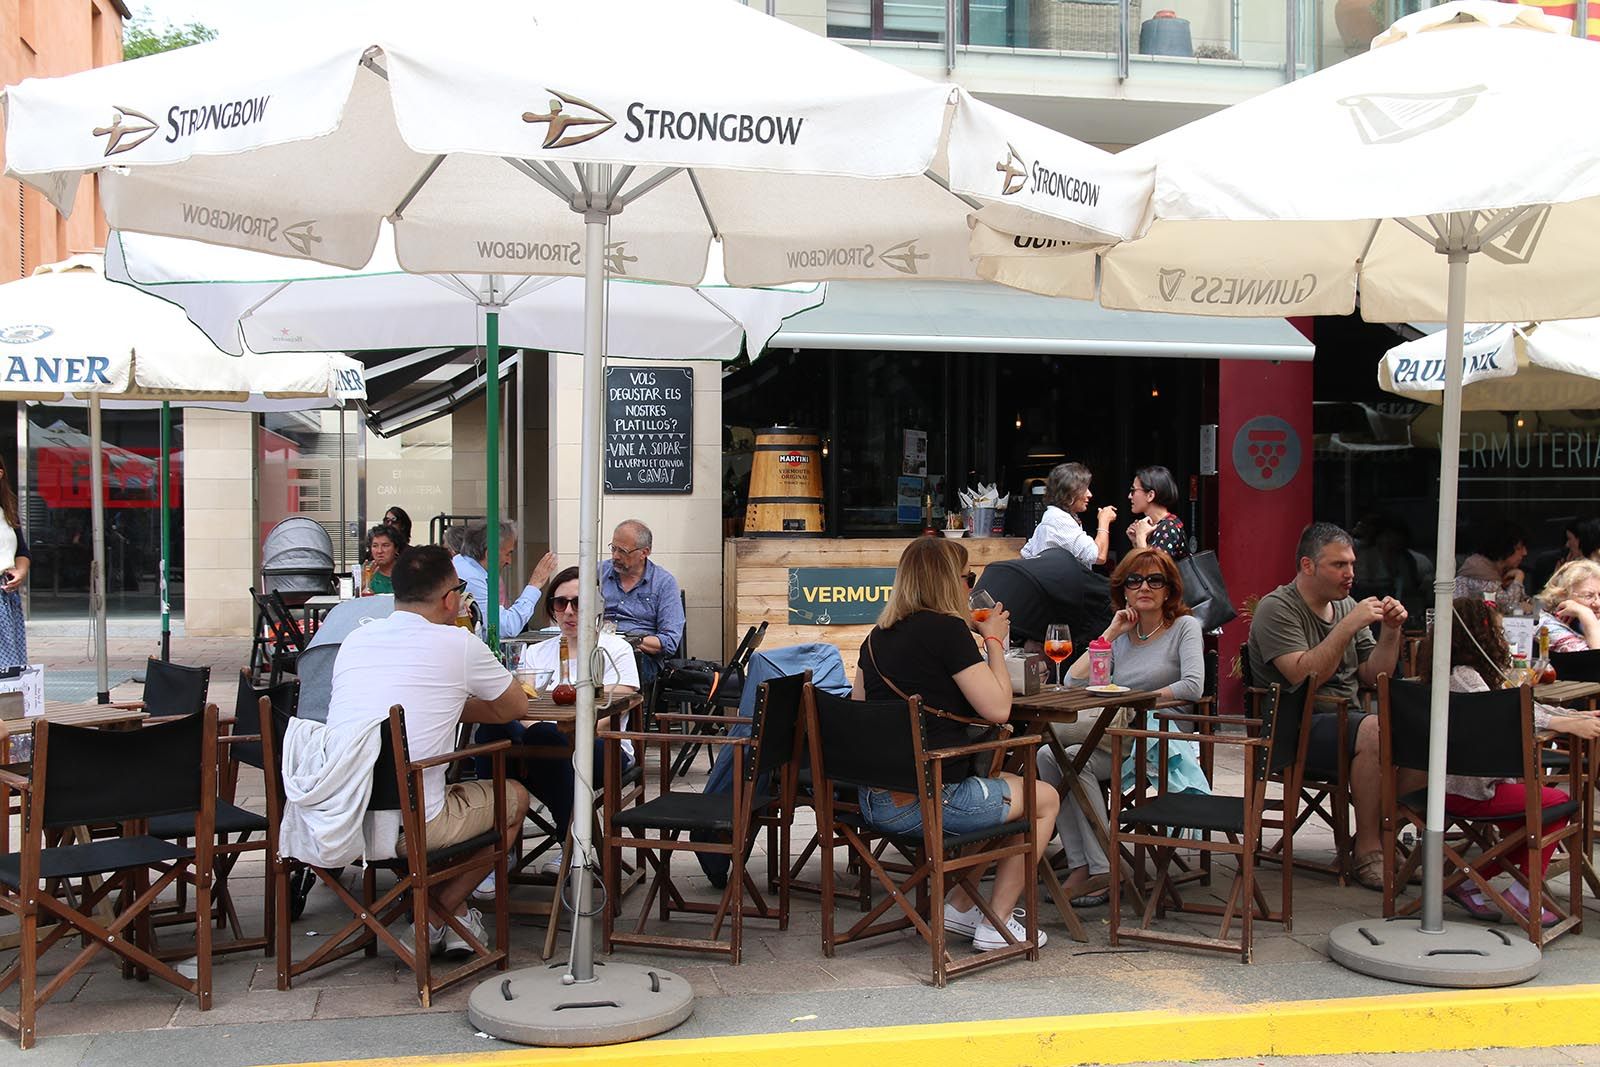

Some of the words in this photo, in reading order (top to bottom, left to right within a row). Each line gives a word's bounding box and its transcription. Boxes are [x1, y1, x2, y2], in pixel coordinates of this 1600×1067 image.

[165, 95, 270, 144] STRONGBOW
[624, 101, 803, 145] STRONGBOW
[1030, 160, 1100, 207] STRONGBOW
[630, 372, 656, 385] VOLS
[609, 388, 662, 401] DEGUSTAR
[665, 388, 681, 400] ELS
[625, 405, 667, 417] NOSTRES
[609, 443, 635, 457] VINE
[638, 443, 647, 455] A
[650, 441, 681, 455] SOPAR
[780, 455, 809, 463] MARTINI
[638, 468, 675, 484] CAVA!
[803, 586, 893, 603] VERMUT
